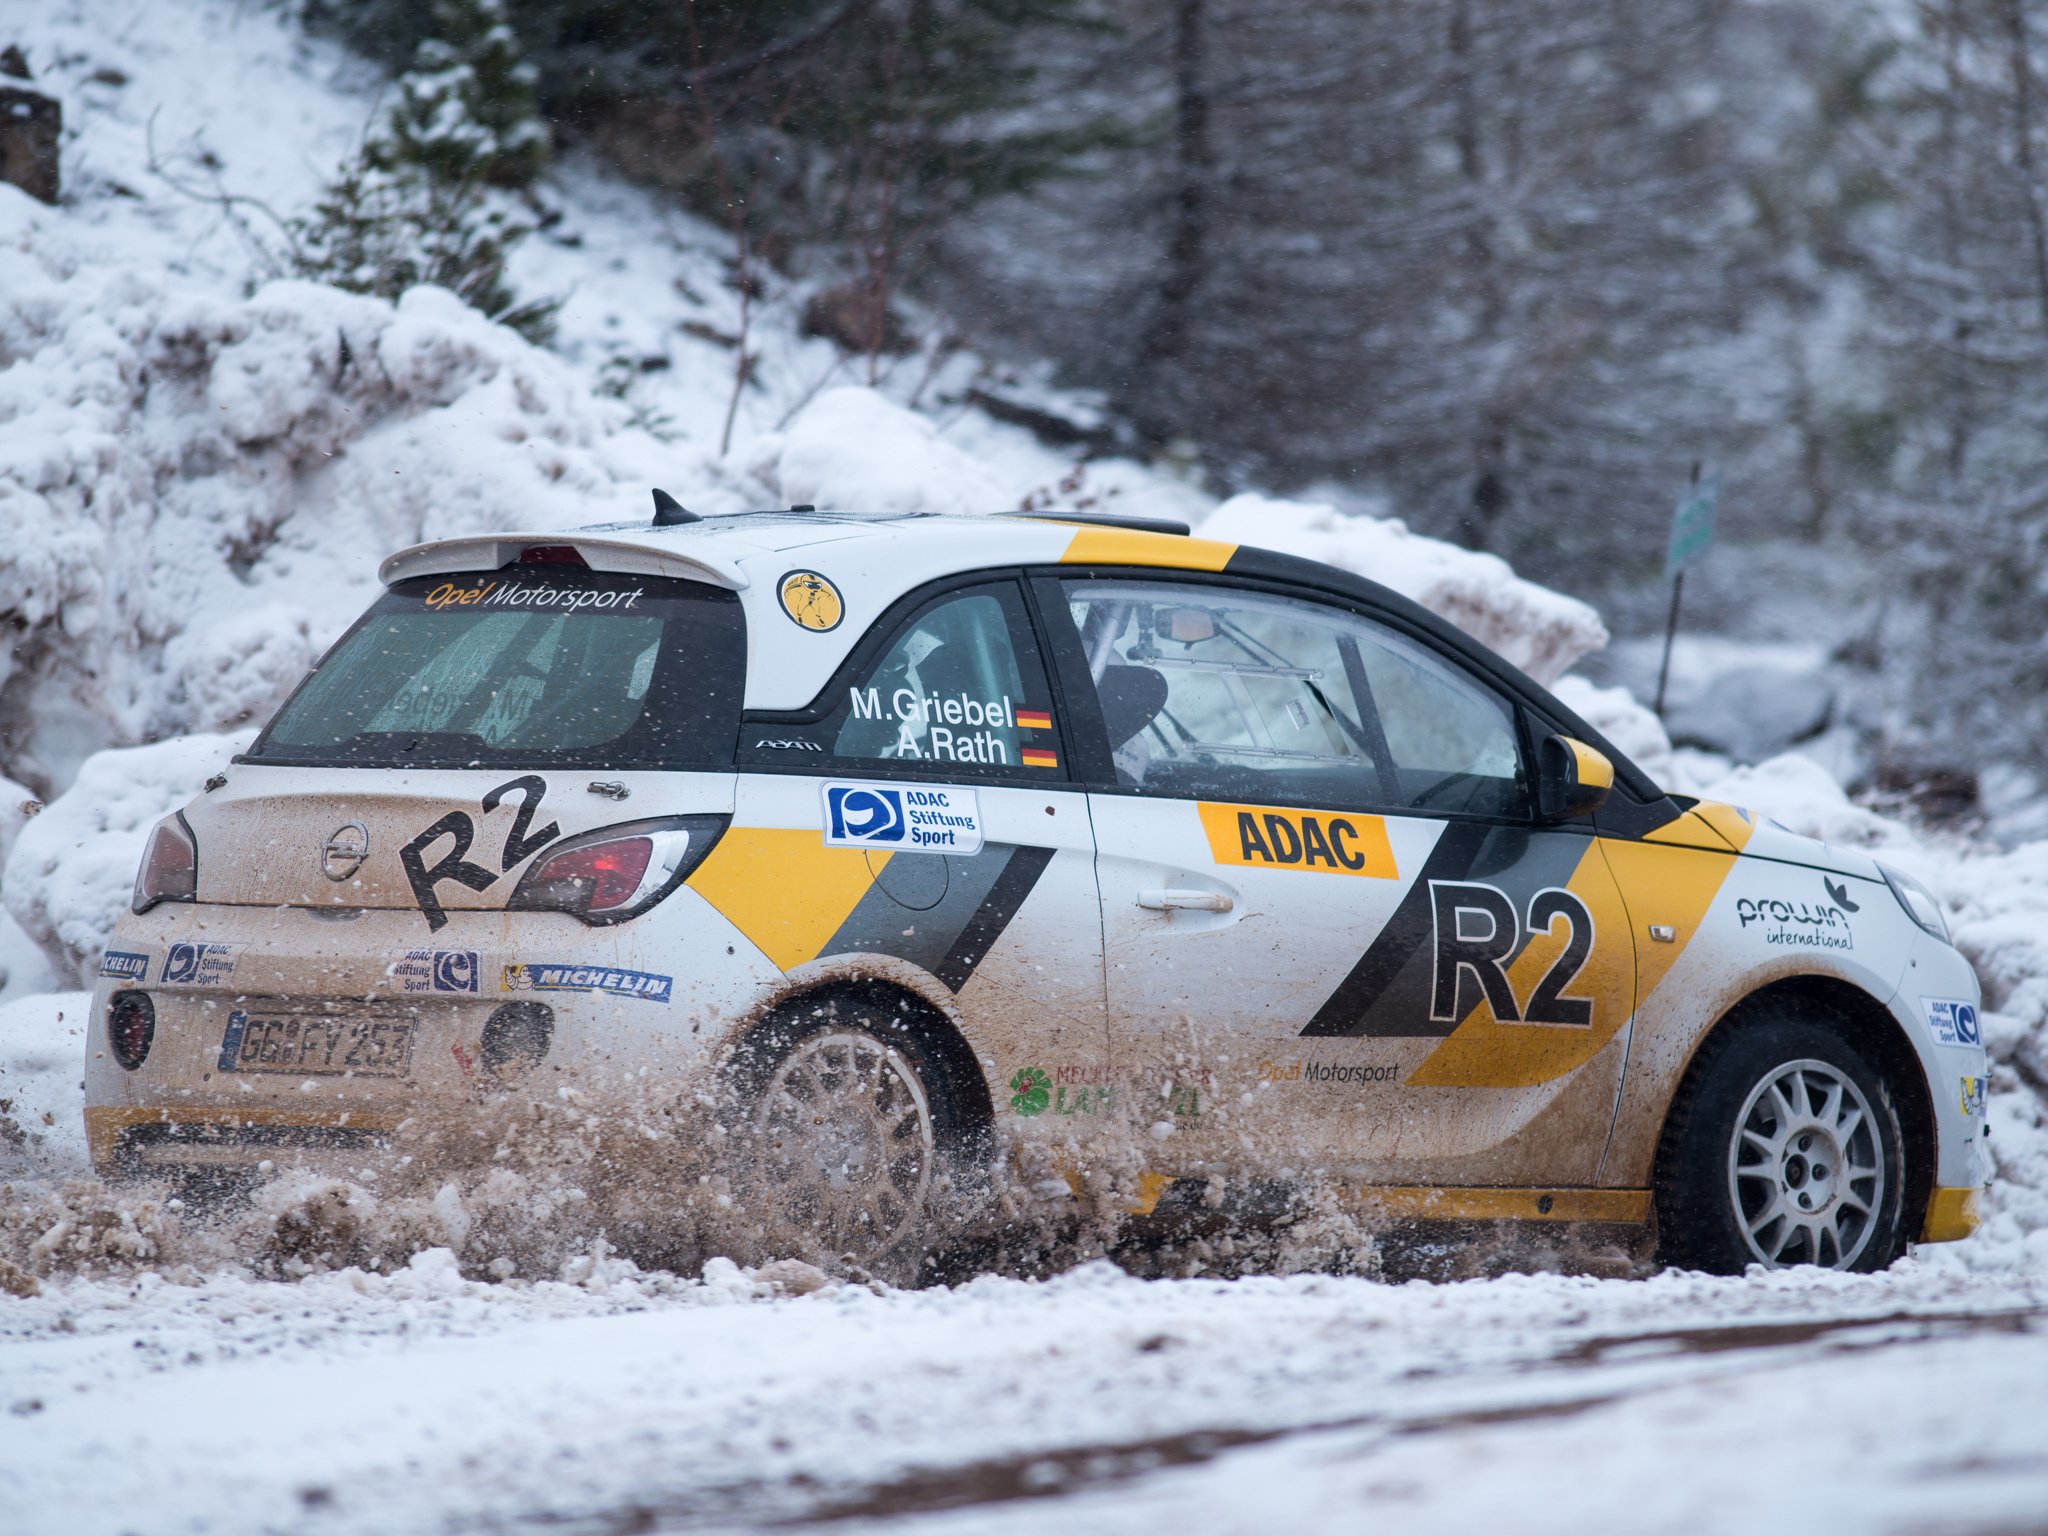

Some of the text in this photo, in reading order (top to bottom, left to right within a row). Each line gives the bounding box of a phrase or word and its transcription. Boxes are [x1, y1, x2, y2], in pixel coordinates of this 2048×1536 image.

[424, 582, 644, 612] Opel Motorsport
[850, 687, 1013, 728] M.Griebel
[898, 726, 1007, 764] A.Rath
[906, 791, 950, 808] ADAC
[909, 810, 976, 830] Stiftung
[911, 828, 955, 846] Sport
[1237, 812, 1365, 870] ADAC
[399, 775, 561, 934] R2
[207, 945, 232, 955] ADAC
[1767, 925, 1854, 951] international
[202, 958, 234, 972] Stiftung
[405, 951, 432, 961] ADAC
[1428, 879, 1596, 1030] R2
[198, 972, 221, 986] Sport
[404, 979, 430, 992] Sport
[538, 968, 669, 995] MICHELIN
[1304, 1061, 1401, 1086] Motorsport
